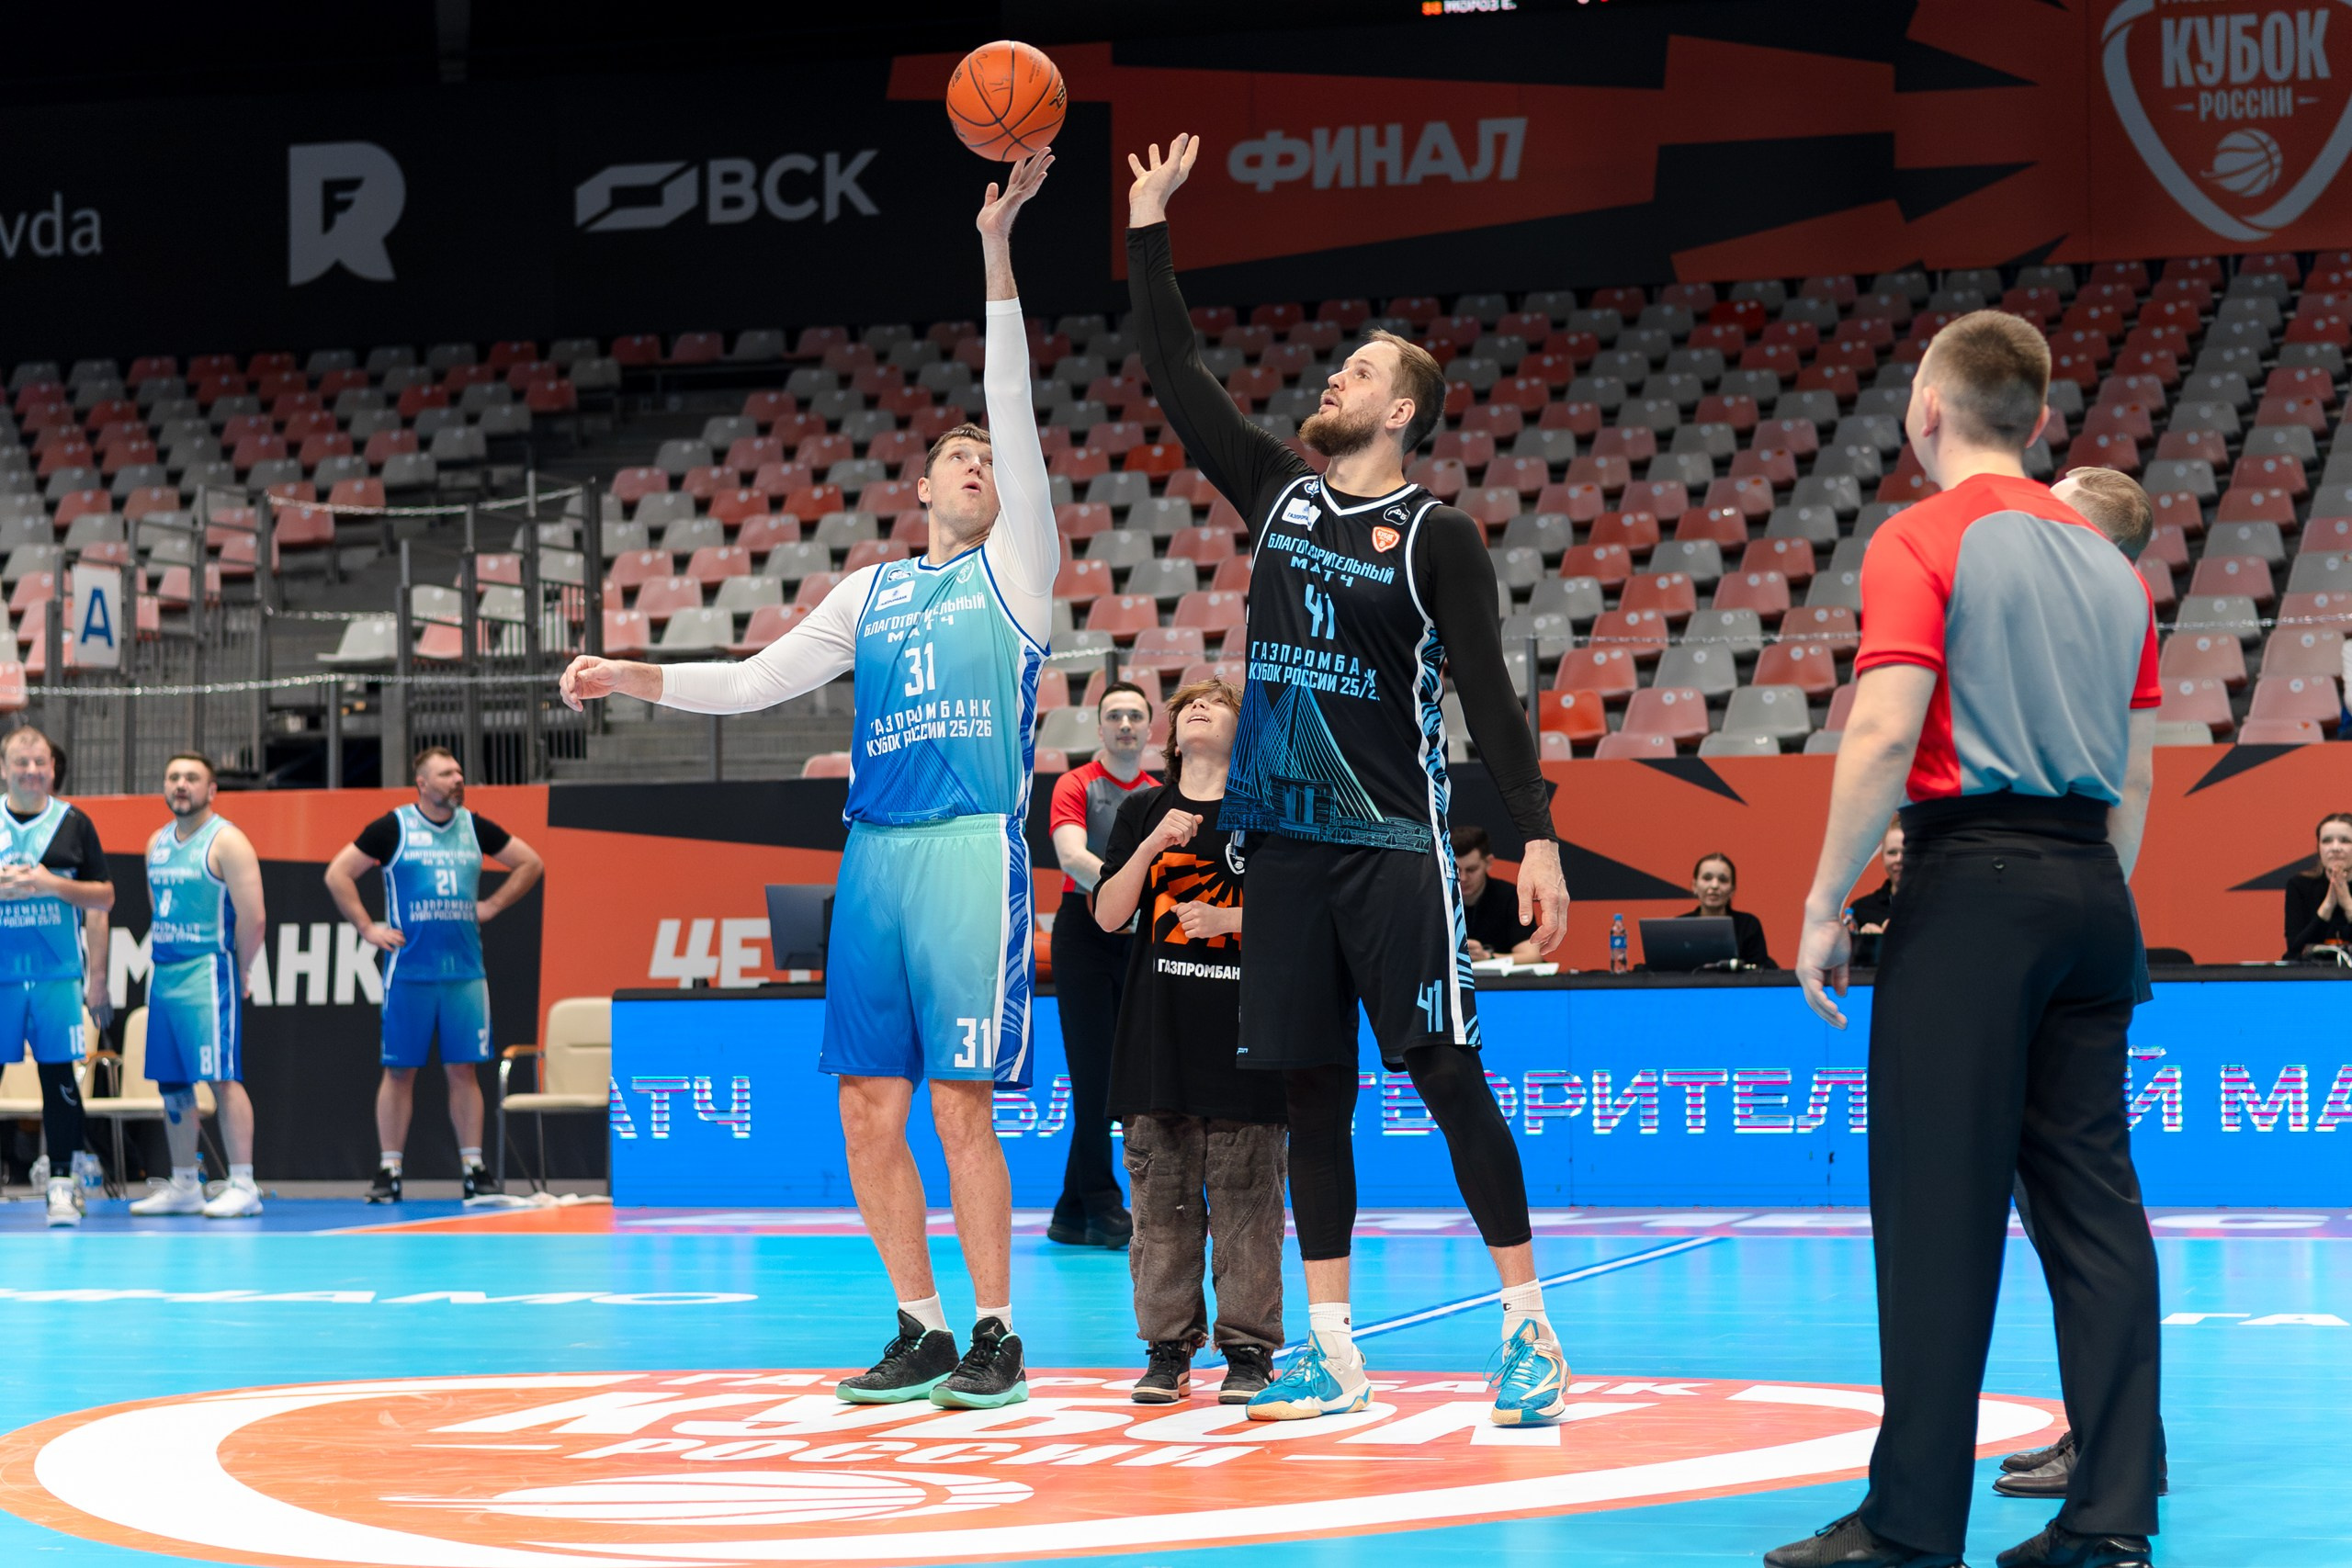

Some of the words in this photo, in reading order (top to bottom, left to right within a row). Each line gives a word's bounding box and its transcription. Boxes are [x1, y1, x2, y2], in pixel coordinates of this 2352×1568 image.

[2161, 7, 2332, 88] КУБОК
[2199, 86, 2293, 122] РОССИИ
[1227, 117, 1529, 193] ФИНАЛ
[707, 150, 880, 226] ВСК
[0, 190, 103, 259] vda
[1290, 555, 1354, 588] МАТЧ
[888, 614, 955, 643] МАТЧ
[1305, 584, 1335, 640] 41
[904, 641, 936, 697] 31
[1248, 662, 1283, 682] КУБОК
[1283, 666, 1338, 692] РОССИИ
[1340, 676, 1380, 701] 25/2
[1250, 641, 1377, 688] ГАЗПРОМБАК
[866, 732, 902, 757] КУБОК
[949, 718, 992, 738] 25/26
[435, 869, 458, 897] 21
[1158, 958, 1240, 980] ГАЗПРОМБАН
[1417, 979, 1443, 1032] 41
[199, 1045, 213, 1075] 8
[955, 1018, 991, 1068] 31
[428, 1391, 1661, 1449] КУБОК
[563, 1438, 1265, 1468] РОССИИ
